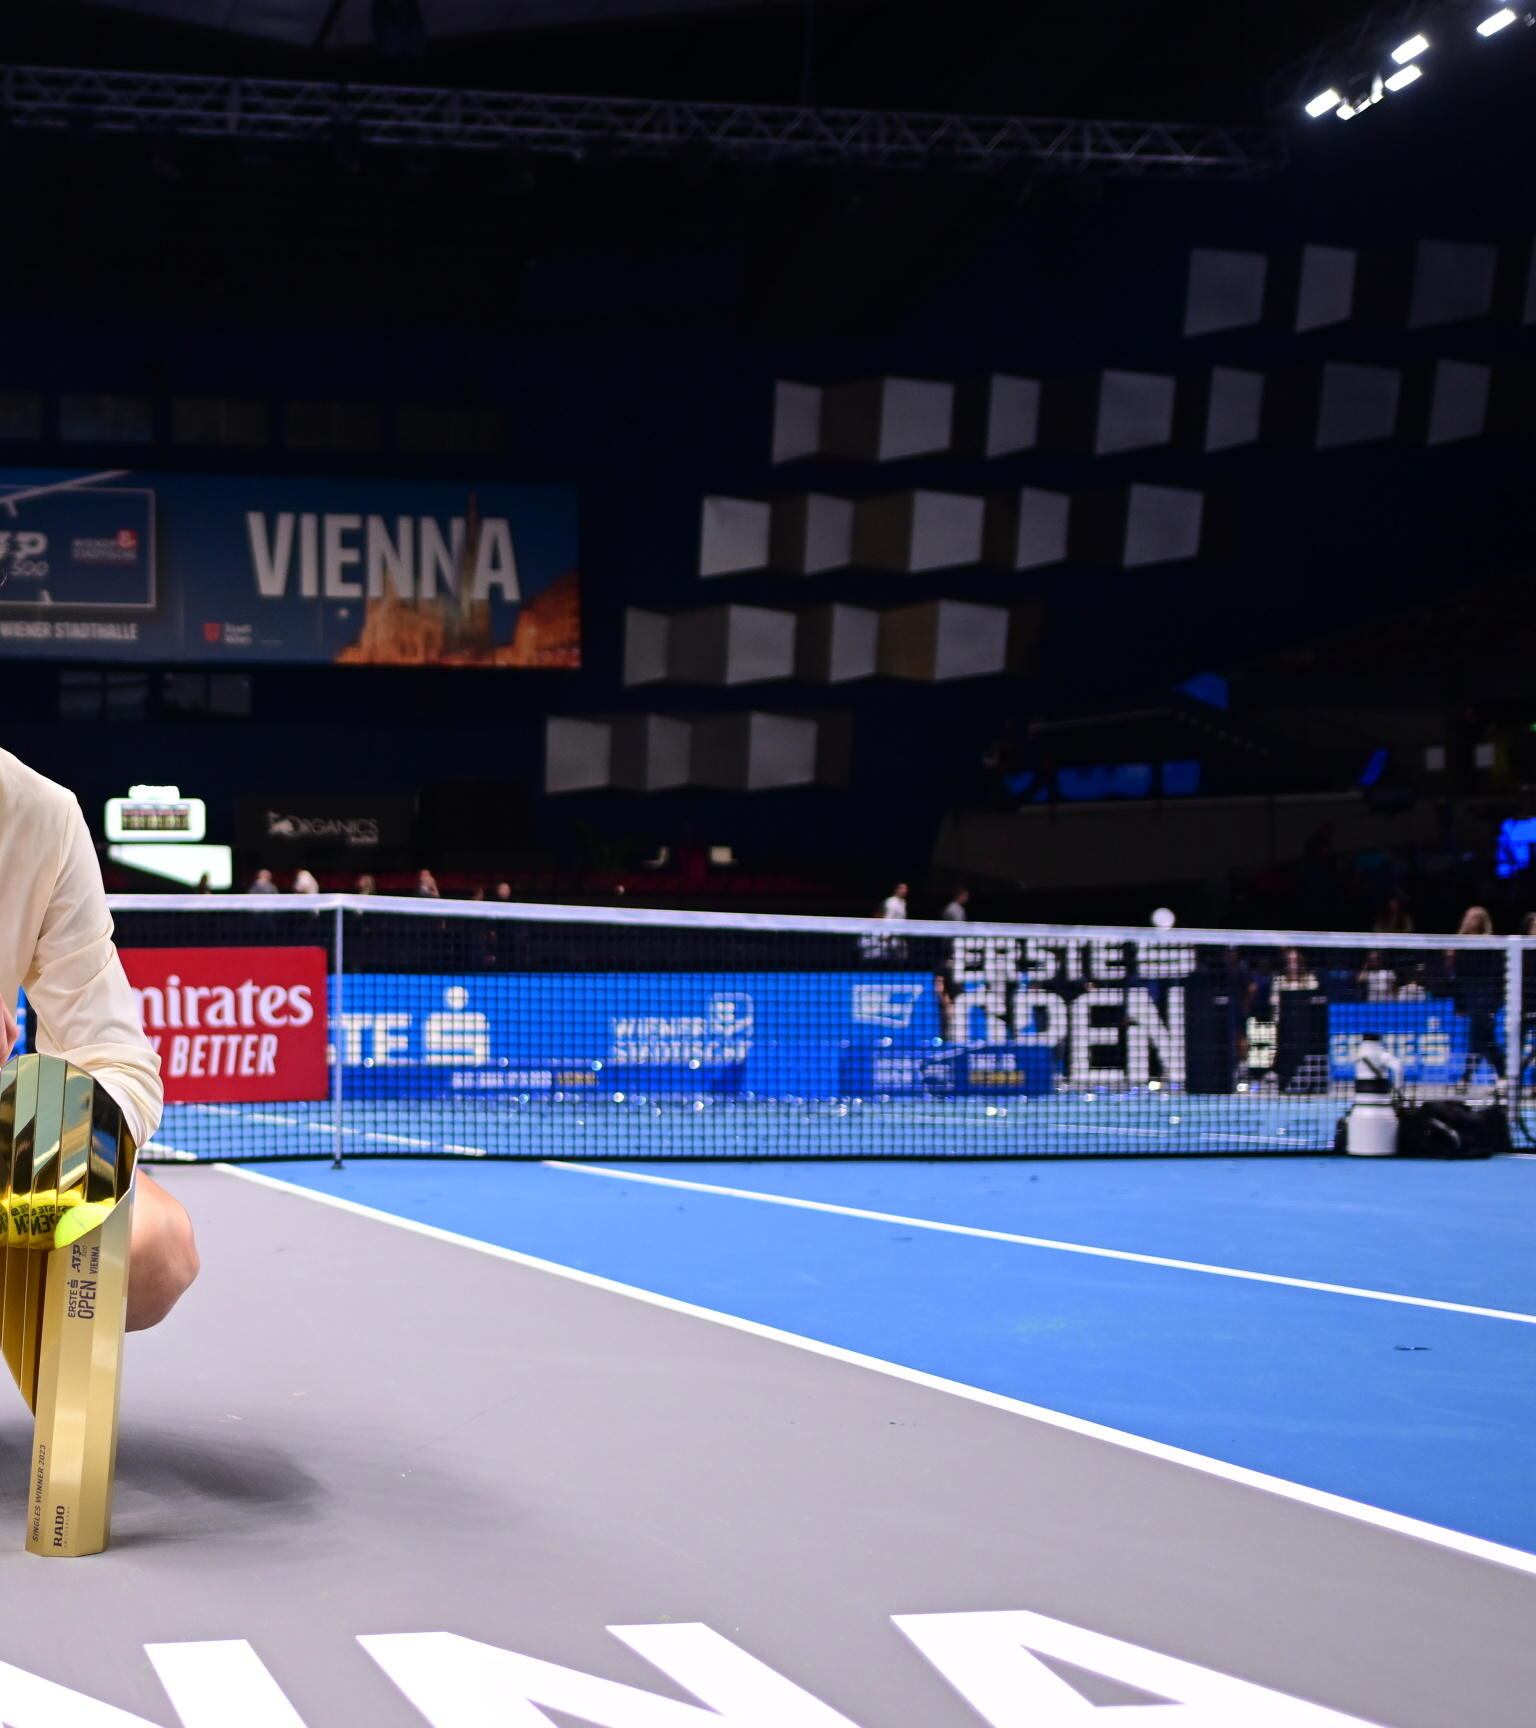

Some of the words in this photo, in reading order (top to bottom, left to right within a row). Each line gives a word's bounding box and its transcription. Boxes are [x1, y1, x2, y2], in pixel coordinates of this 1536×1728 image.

[11, 561, 49, 577] 500
[247, 510, 521, 602] VIENNA
[54, 622, 139, 640] STADTHALLE
[953, 936, 1128, 981] ERSTE
[131, 974, 314, 1030] mirates
[949, 984, 1186, 1083] OPEN
[167, 1033, 278, 1078] BETTER
[71, 1244, 82, 1273] ATP
[89, 1246, 100, 1275] VIENNA
[67, 1289, 79, 1318] ERSTE
[77, 1280, 97, 1320] OPEN
[38, 1444, 47, 1467] 2023
[35, 1467, 44, 1503] WINNER
[32, 1505, 42, 1542] SINGLES
[53, 1505, 66, 1547] RADO
